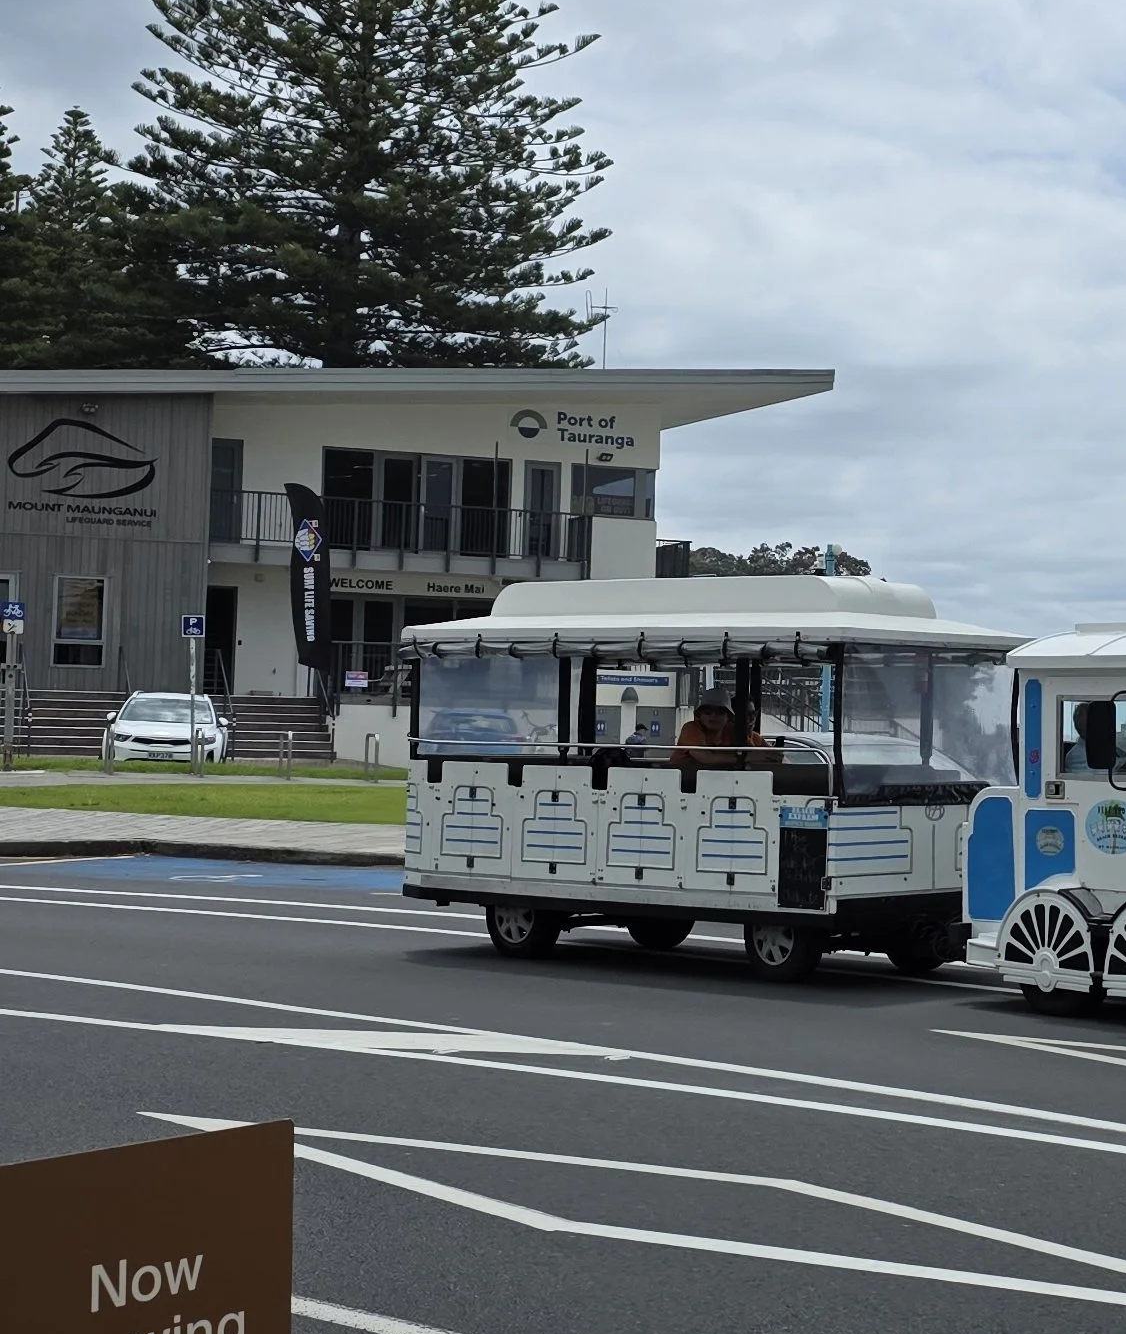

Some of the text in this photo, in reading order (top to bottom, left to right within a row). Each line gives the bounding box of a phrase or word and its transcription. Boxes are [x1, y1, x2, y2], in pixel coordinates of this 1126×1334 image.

[557, 411, 616, 429] Port of
[557, 428, 635, 449] Tauranga
[8, 500, 157, 518] MOUNT MAUNGANUI
[66, 517, 152, 528] LIFEGUARD SERVICE
[330, 577, 485, 595] WELCOME Haere Mai
[303, 566, 316, 642] SURF LIFE SAVING
[189, 617, 198, 627] P
[90, 1254, 204, 1313] Now
